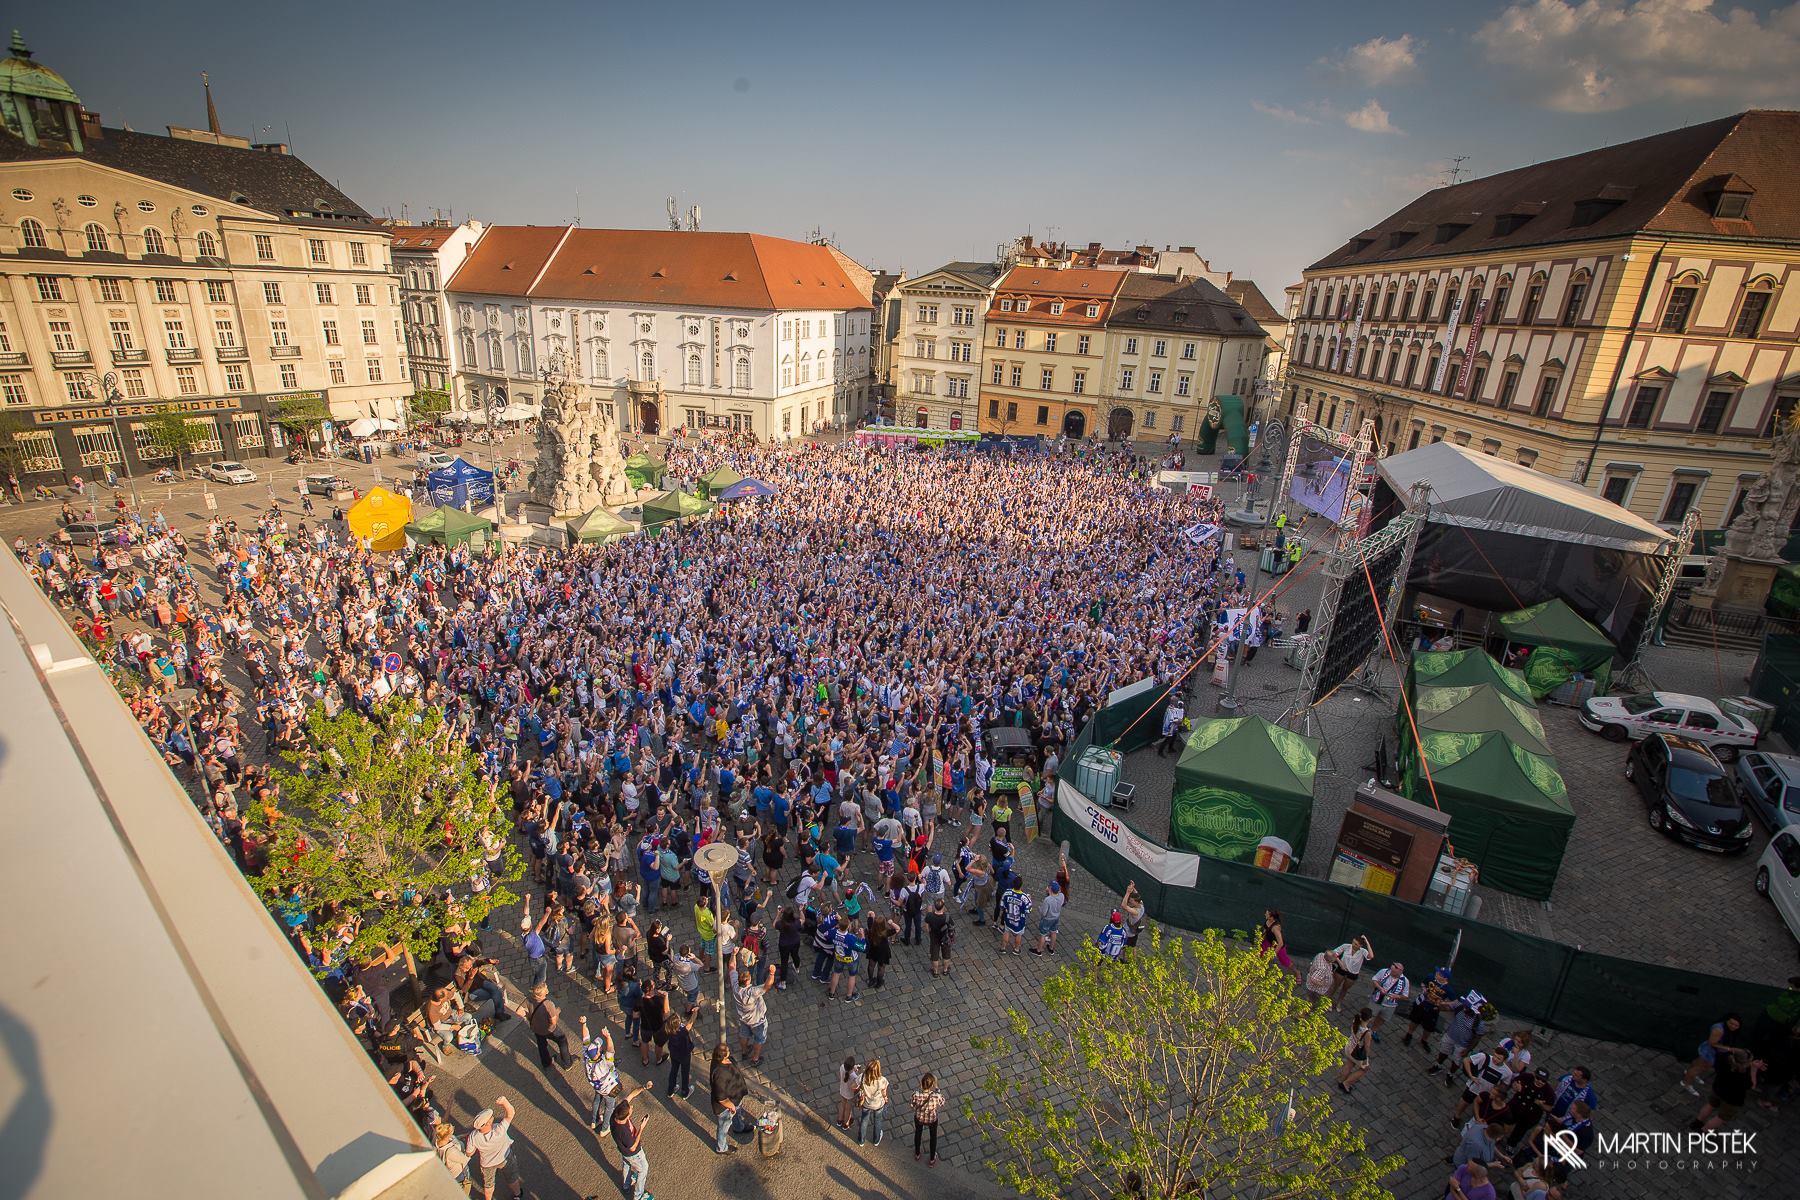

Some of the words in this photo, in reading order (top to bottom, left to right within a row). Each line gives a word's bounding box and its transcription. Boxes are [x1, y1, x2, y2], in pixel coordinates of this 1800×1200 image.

[40, 404, 168, 422] GRANDEZZA
[175, 400, 238, 412] HOTEL
[1091, 819, 1118, 844] FUND
